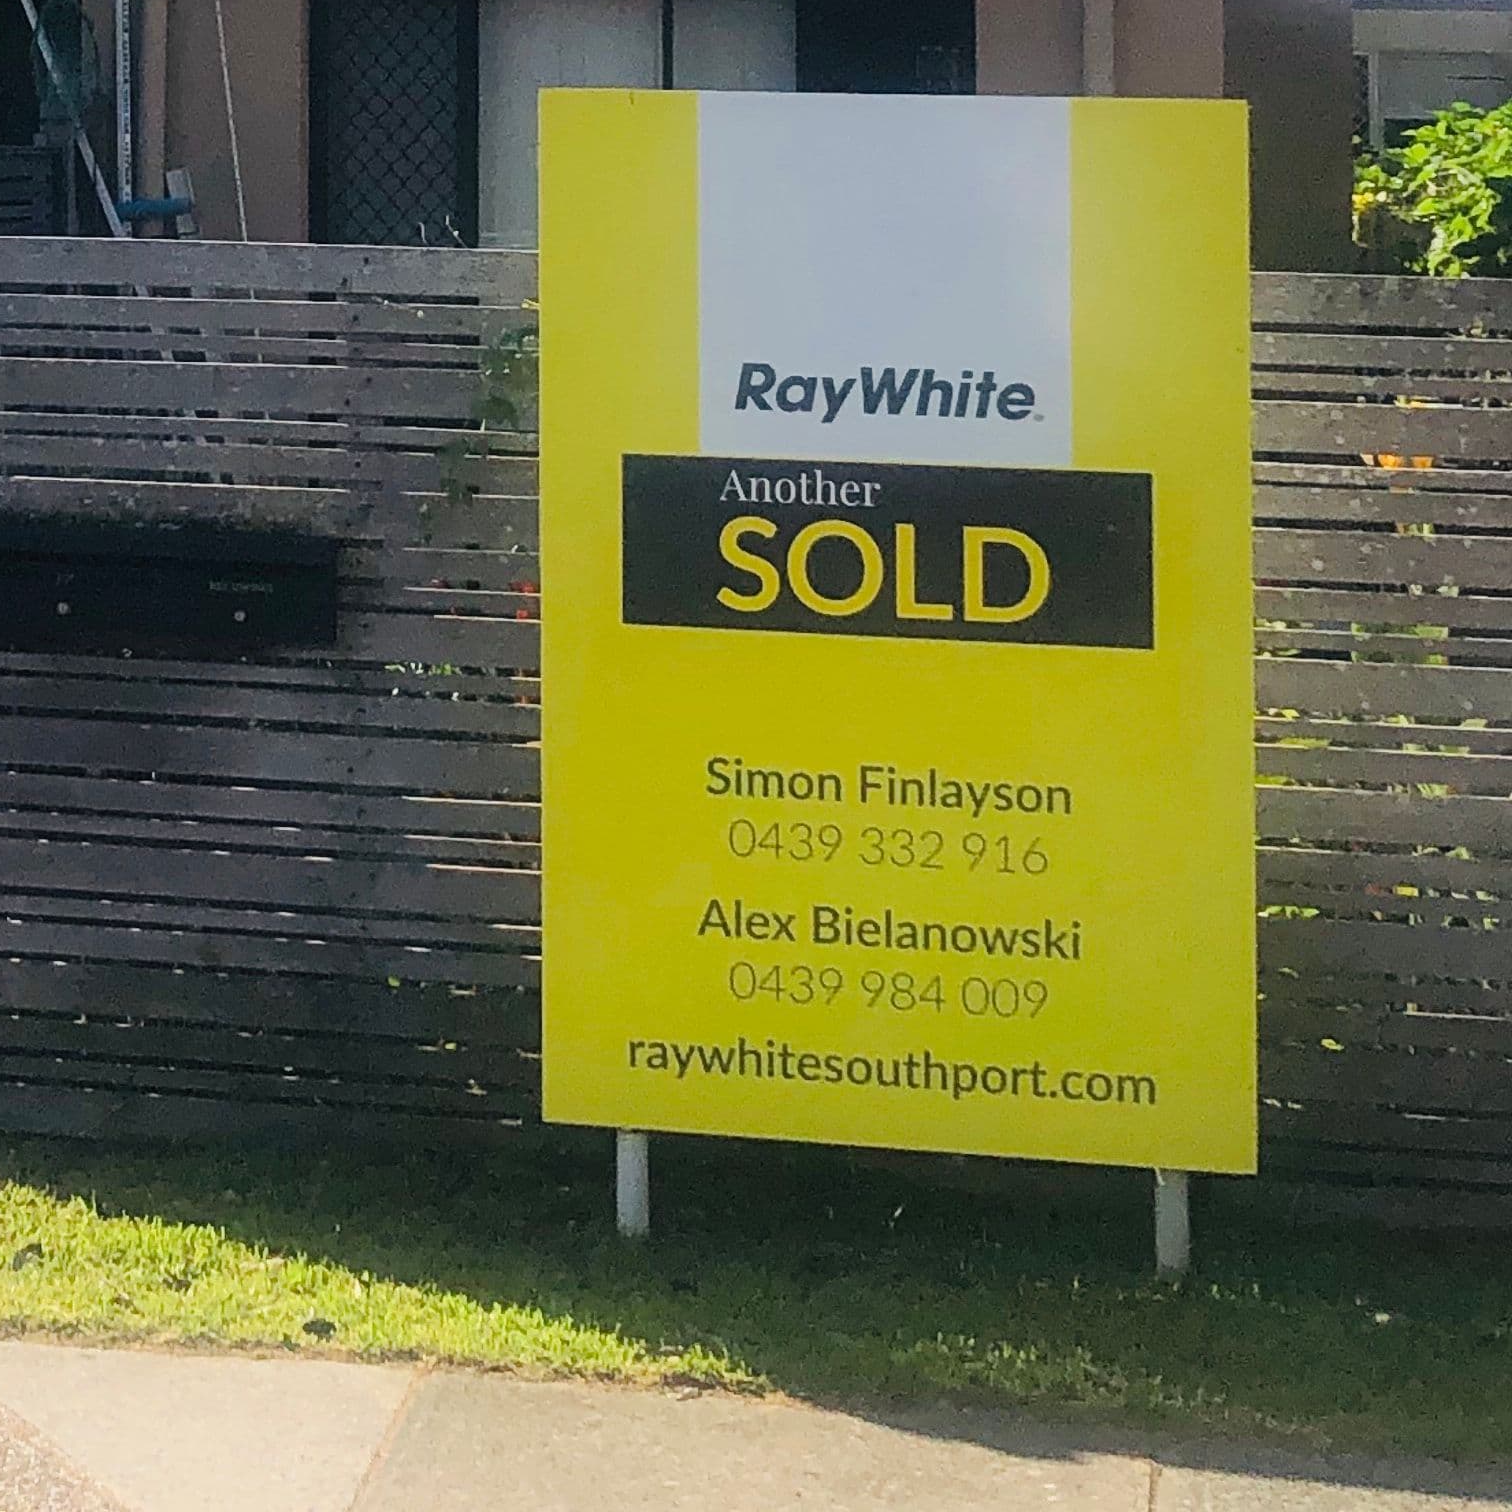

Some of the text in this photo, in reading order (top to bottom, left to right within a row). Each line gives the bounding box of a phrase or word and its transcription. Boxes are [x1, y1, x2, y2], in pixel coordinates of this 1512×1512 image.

[719, 467, 881, 508] Another
[716, 516, 1050, 623] SOLD
[706, 756, 1072, 819] Simon Finlayson
[728, 818, 1049, 875] 0439 332 916
[697, 898, 1081, 961] Alex Bielanowski
[729, 961, 1048, 1019] 0439 984 009
[629, 1036, 1156, 1105] raywhitesouthport.com
